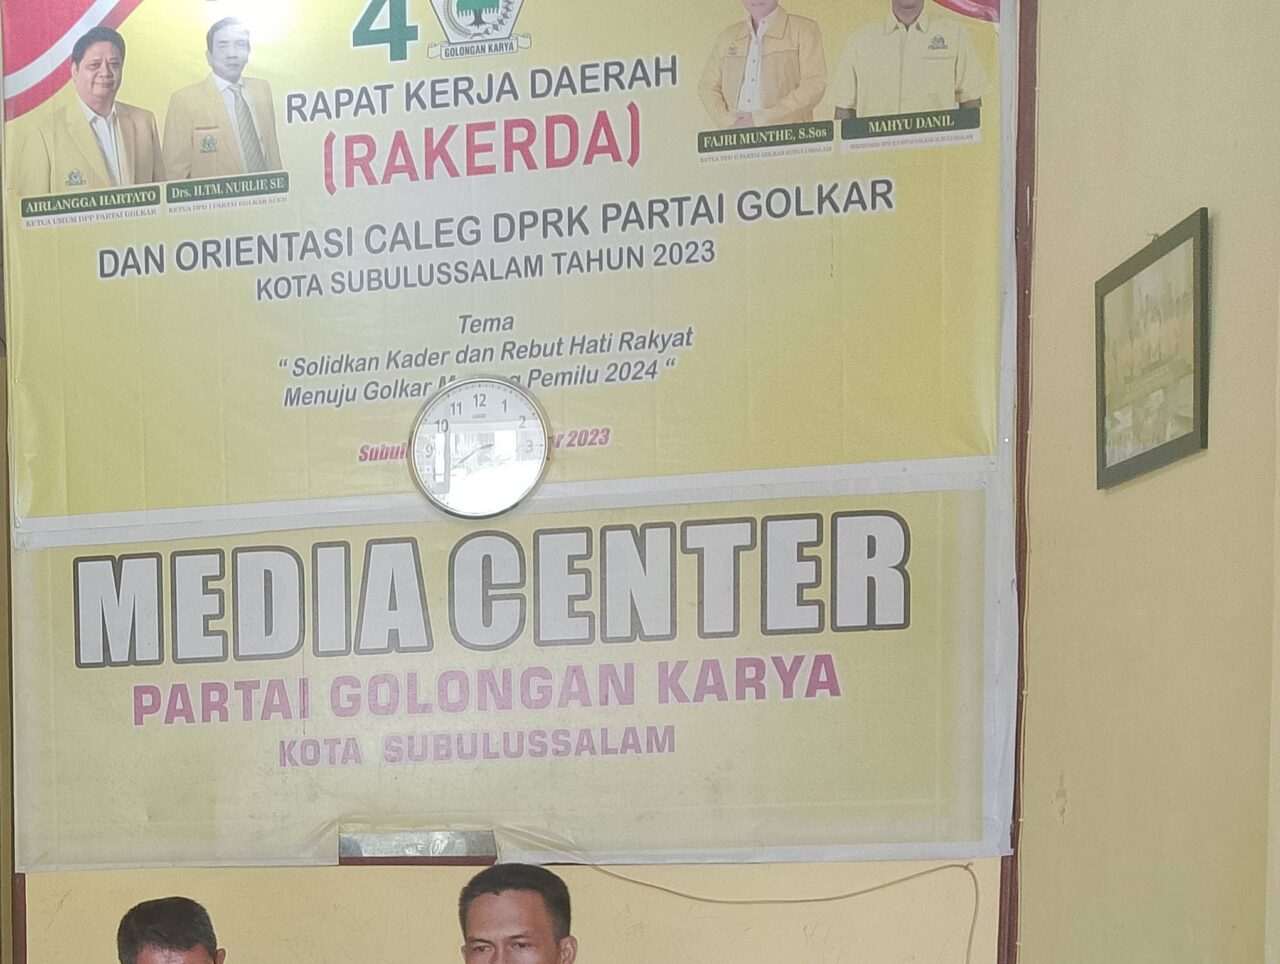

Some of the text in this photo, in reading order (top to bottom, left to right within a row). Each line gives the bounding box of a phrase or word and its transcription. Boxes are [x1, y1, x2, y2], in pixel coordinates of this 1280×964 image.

[352, 0, 419, 62] 4
[444, 41, 515, 58] GOLONGAN KARYA
[287, 55, 677, 123] RAPAT KERJA DAERAH
[868, 116, 955, 133] MAHYU DANIL
[324, 102, 640, 195] (RAKERDA)
[704, 133, 737, 148] FAJRI
[798, 127, 827, 140] S.Sos
[270, 177, 284, 189] SE
[26, 190, 156, 214] AIRLANGGA HARTATO
[99, 179, 894, 278] DAN ORIENTASI CALEG DPRK PARTAI GOLKAR
[256, 239, 715, 301] KOTA SUBULUSSALAM TAHUN 2023
[458, 315, 514, 335] Tema
[292, 355, 380, 378] Solidkan
[385, 348, 450, 371] Kader
[455, 345, 495, 365] dan
[500, 338, 564, 362] Rebut
[568, 333, 612, 355] Hati
[618, 326, 693, 353] Rakyat
[284, 380, 357, 408] Menuju
[363, 374, 433, 400] Golkar
[527, 361, 600, 389] Pemilu
[604, 361, 659, 383] 2024
[450, 402, 463, 416] 11
[473, 393, 487, 408] 12
[502, 400, 508, 413] 1
[435, 419, 449, 433] 10
[519, 416, 527, 429] 2
[566, 429, 610, 448] 2023
[72, 509, 912, 670] MEDIA CENTER
[132, 653, 842, 727] PARTAI GOLONGAN KARYA
[278, 723, 675, 768] KOTA SUBULUSSALAM
